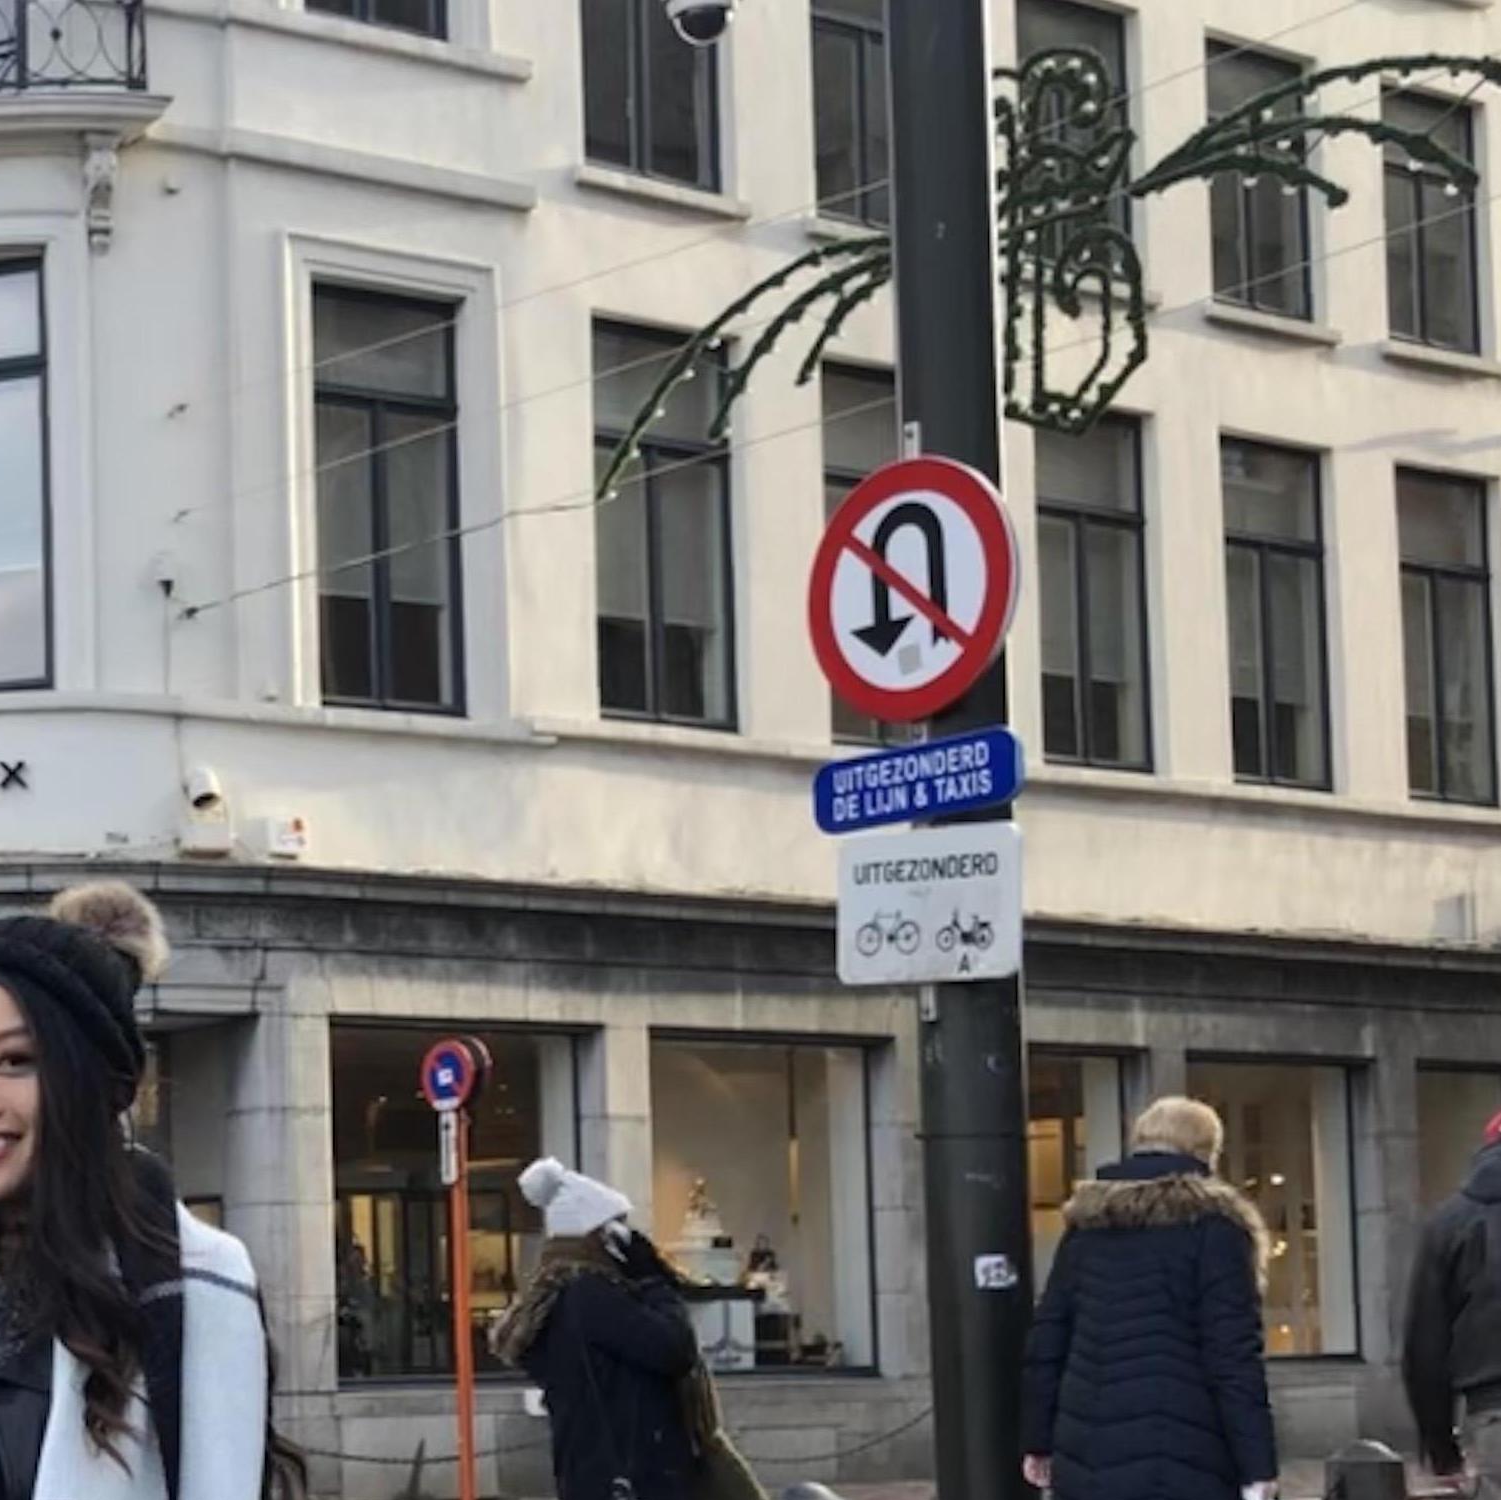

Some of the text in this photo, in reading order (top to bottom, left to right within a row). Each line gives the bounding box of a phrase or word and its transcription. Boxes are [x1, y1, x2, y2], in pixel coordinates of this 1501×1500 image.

[832, 741, 990, 795] UITGEZONDERD
[832, 769, 993, 822] DE LIJN & TAXIS
[853, 852, 998, 886] UITGEZONDERD
[957, 952, 971, 974] A
